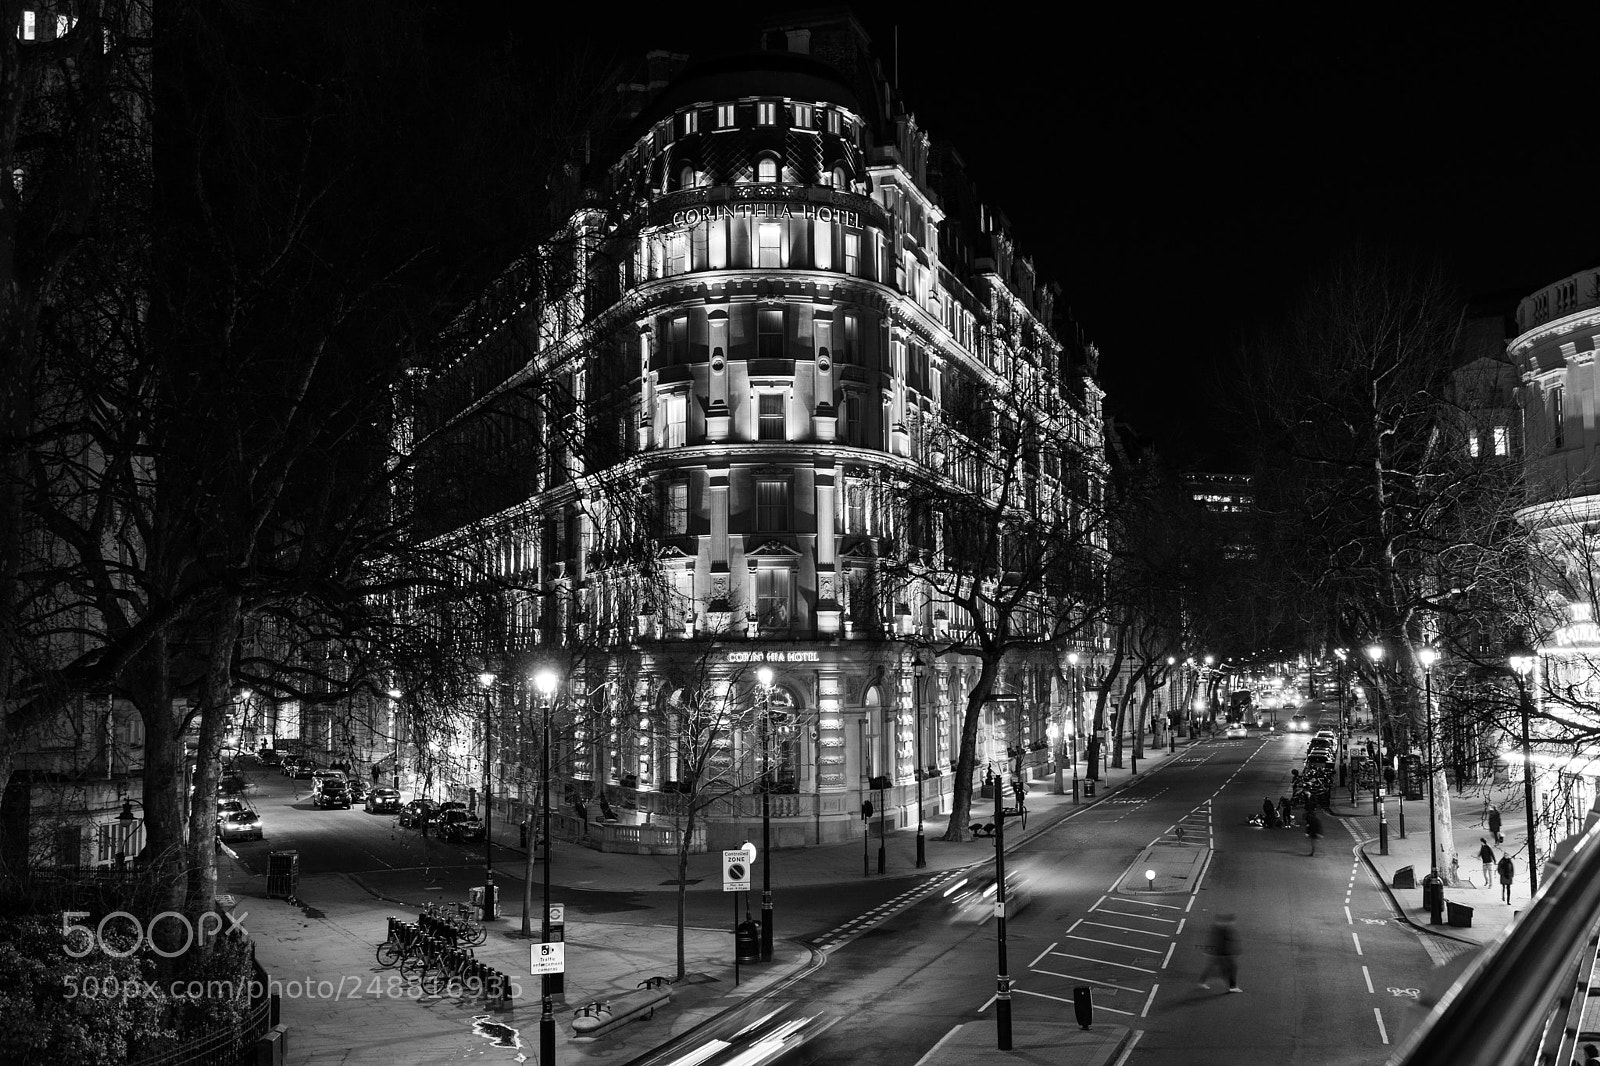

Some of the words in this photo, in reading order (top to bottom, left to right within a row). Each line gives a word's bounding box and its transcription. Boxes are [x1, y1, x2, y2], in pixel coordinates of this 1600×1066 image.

[673, 203, 794, 227] CORINTHIA
[803, 204, 864, 230] HOTEL
[787, 651, 820, 662] HOTEL
